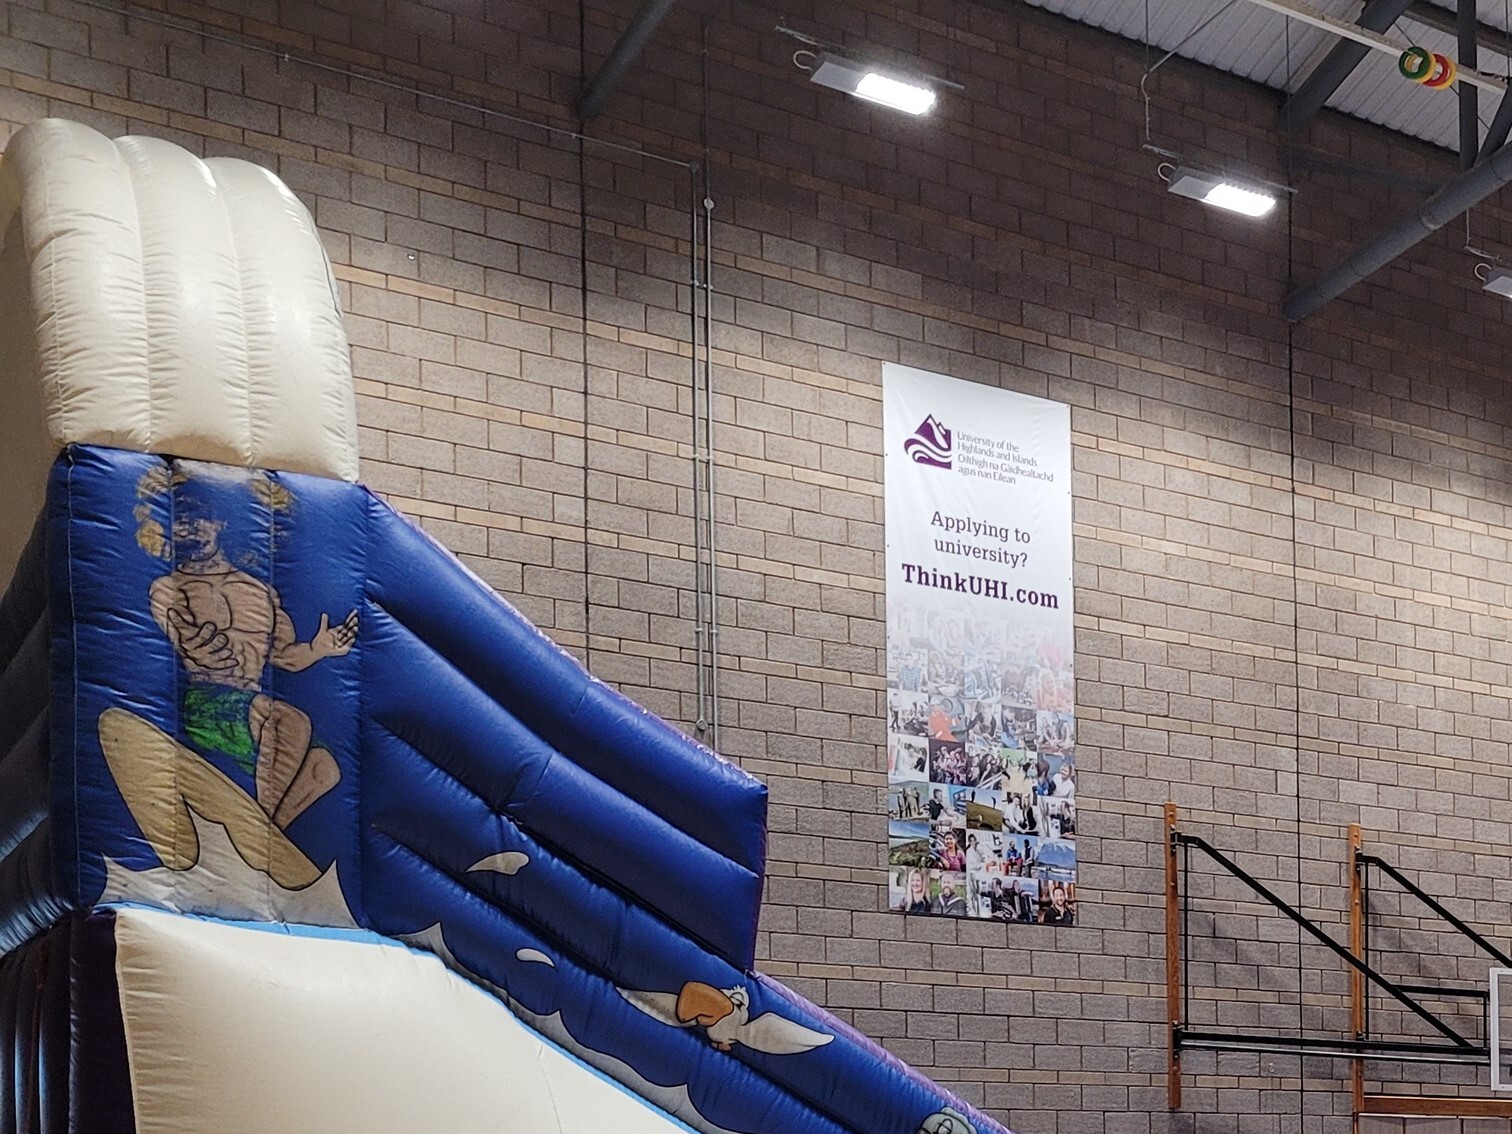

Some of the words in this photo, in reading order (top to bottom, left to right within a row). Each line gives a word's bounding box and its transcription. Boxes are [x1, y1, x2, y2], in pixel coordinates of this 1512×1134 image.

[957, 430, 996, 449] University
[996, 439, 1005, 450] of
[1006, 441, 1020, 453] the
[957, 441, 995, 458] Highlands
[996, 451, 1011, 462] and
[1012, 453, 1038, 467] Islands
[958, 465, 976, 477] agus
[977, 469, 992, 480] nan
[989, 462, 999, 471] na
[930, 510, 1009, 543] Applying
[1015, 527, 1031, 544] to
[933, 539, 1028, 569] university?
[901, 562, 1059, 610] ThinkUHI.com
